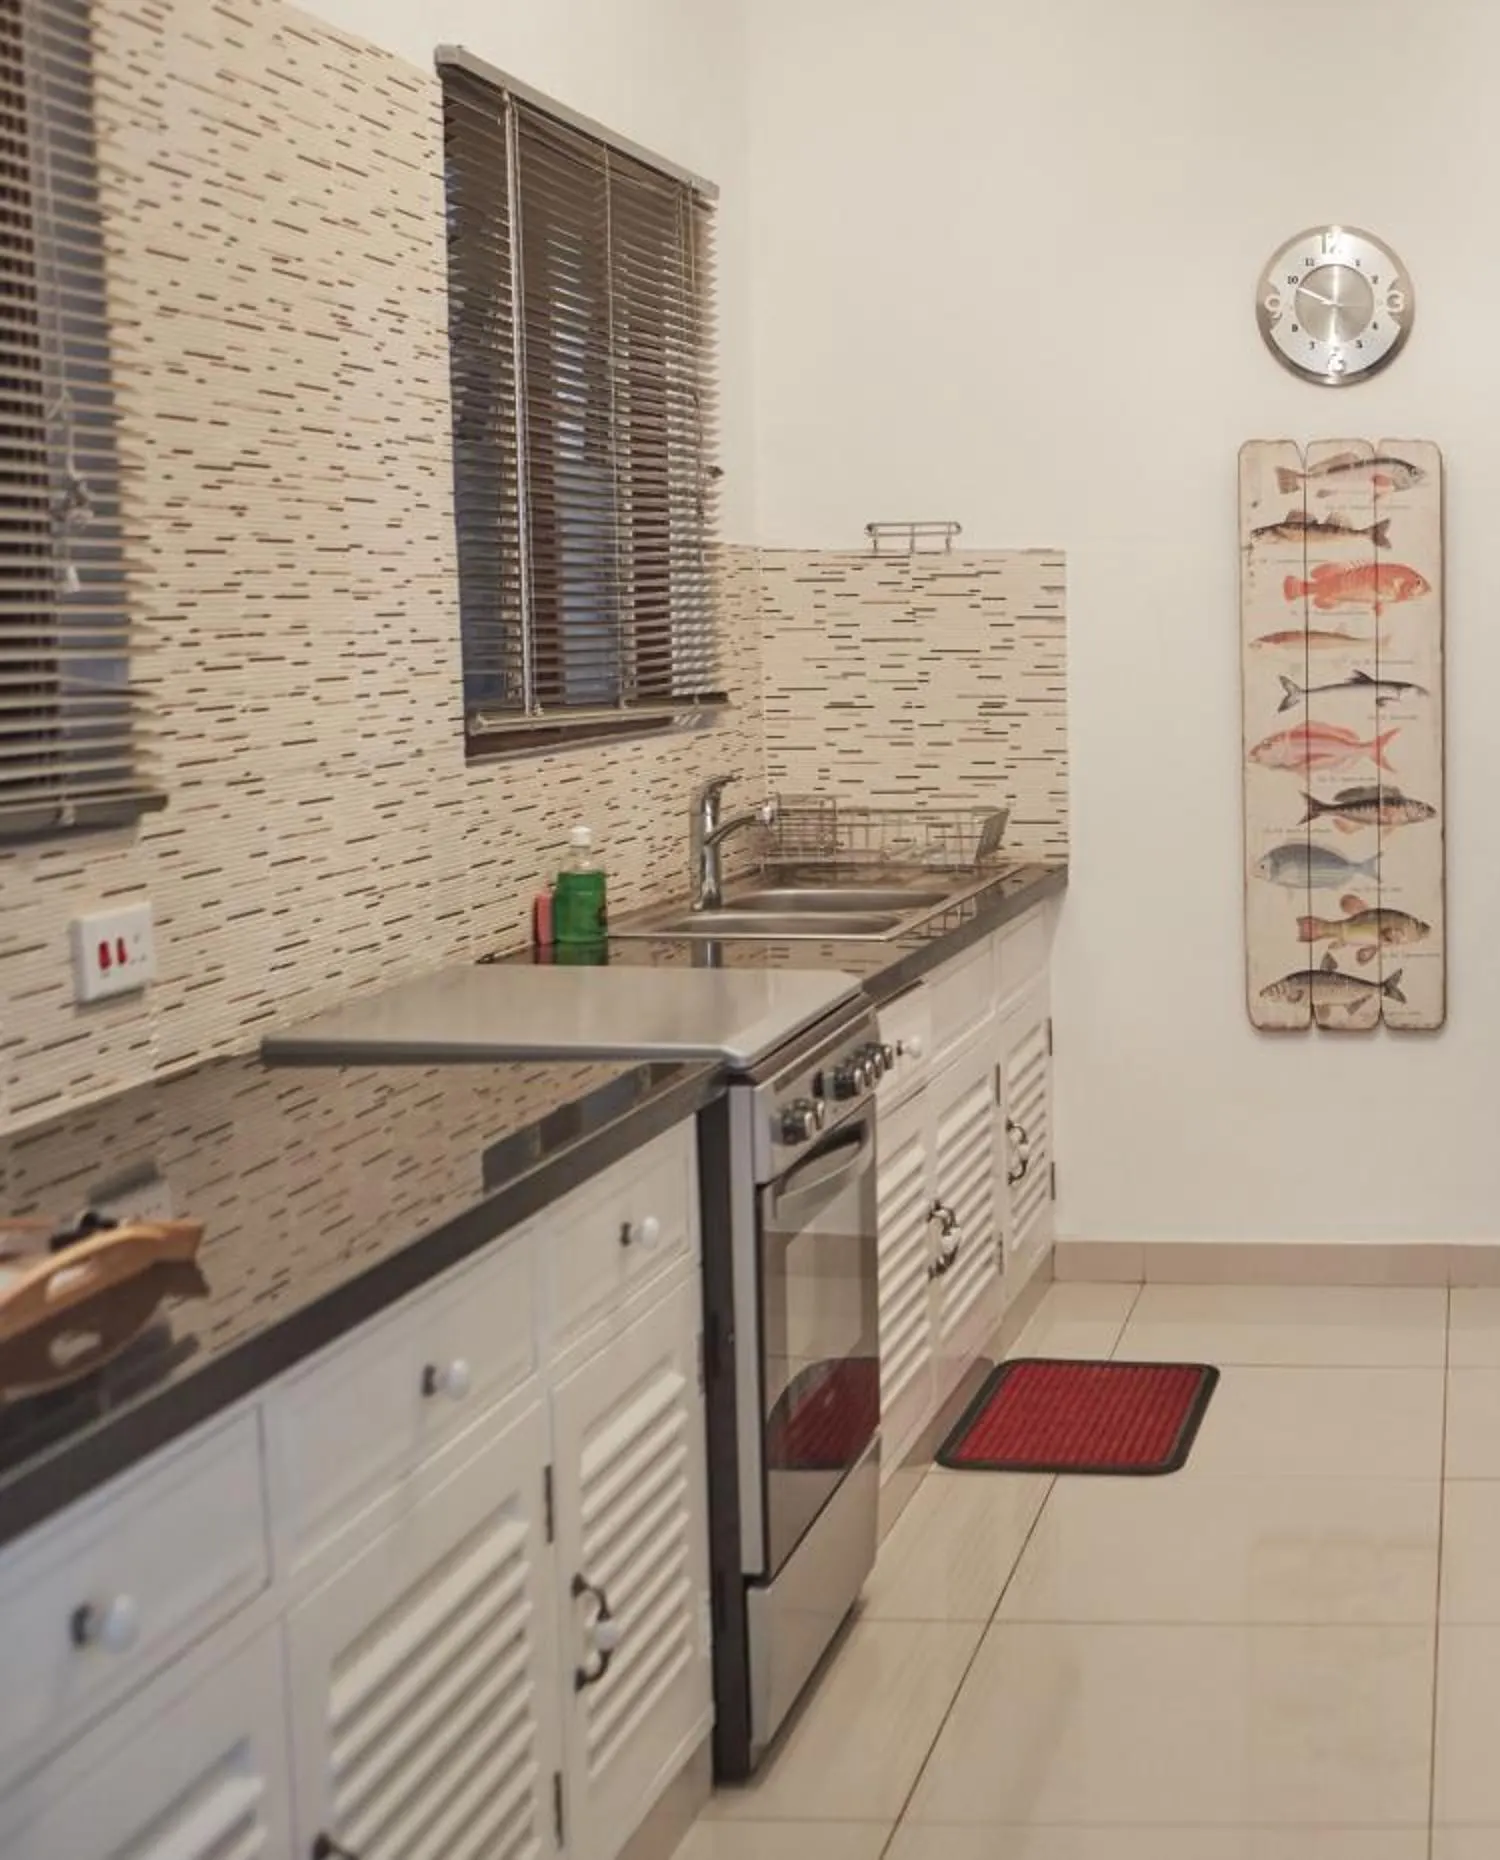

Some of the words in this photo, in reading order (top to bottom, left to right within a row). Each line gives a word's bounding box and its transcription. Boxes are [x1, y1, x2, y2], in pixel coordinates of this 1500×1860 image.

[1305, 258, 1315, 267] 11
[1287, 275, 1299, 285] 10
[1264, 293, 1283, 321] 9
